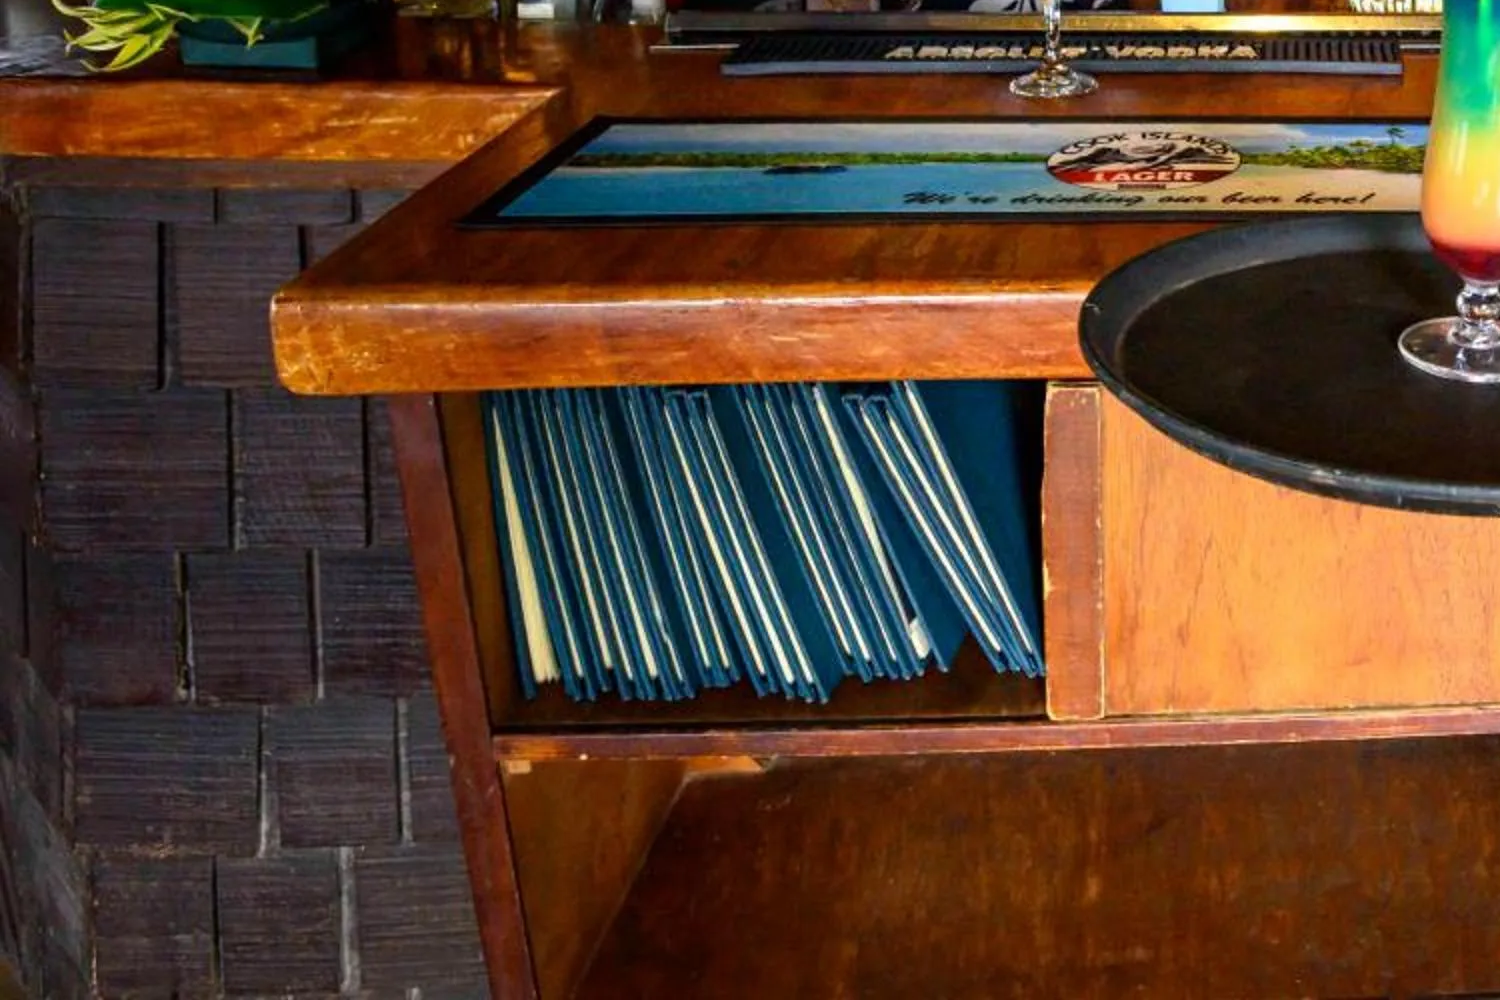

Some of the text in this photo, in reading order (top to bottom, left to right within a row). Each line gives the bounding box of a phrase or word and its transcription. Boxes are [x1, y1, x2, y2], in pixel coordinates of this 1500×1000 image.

[1103, 44, 1259, 60] VODKA
[1061, 132, 1129, 155] COOK
[1093, 171, 1194, 182] LAGER
[1011, 191, 1144, 206] drinking
[1158, 195, 1208, 203] our
[1222, 191, 1280, 204] beer
[1296, 191, 1376, 204] here!
